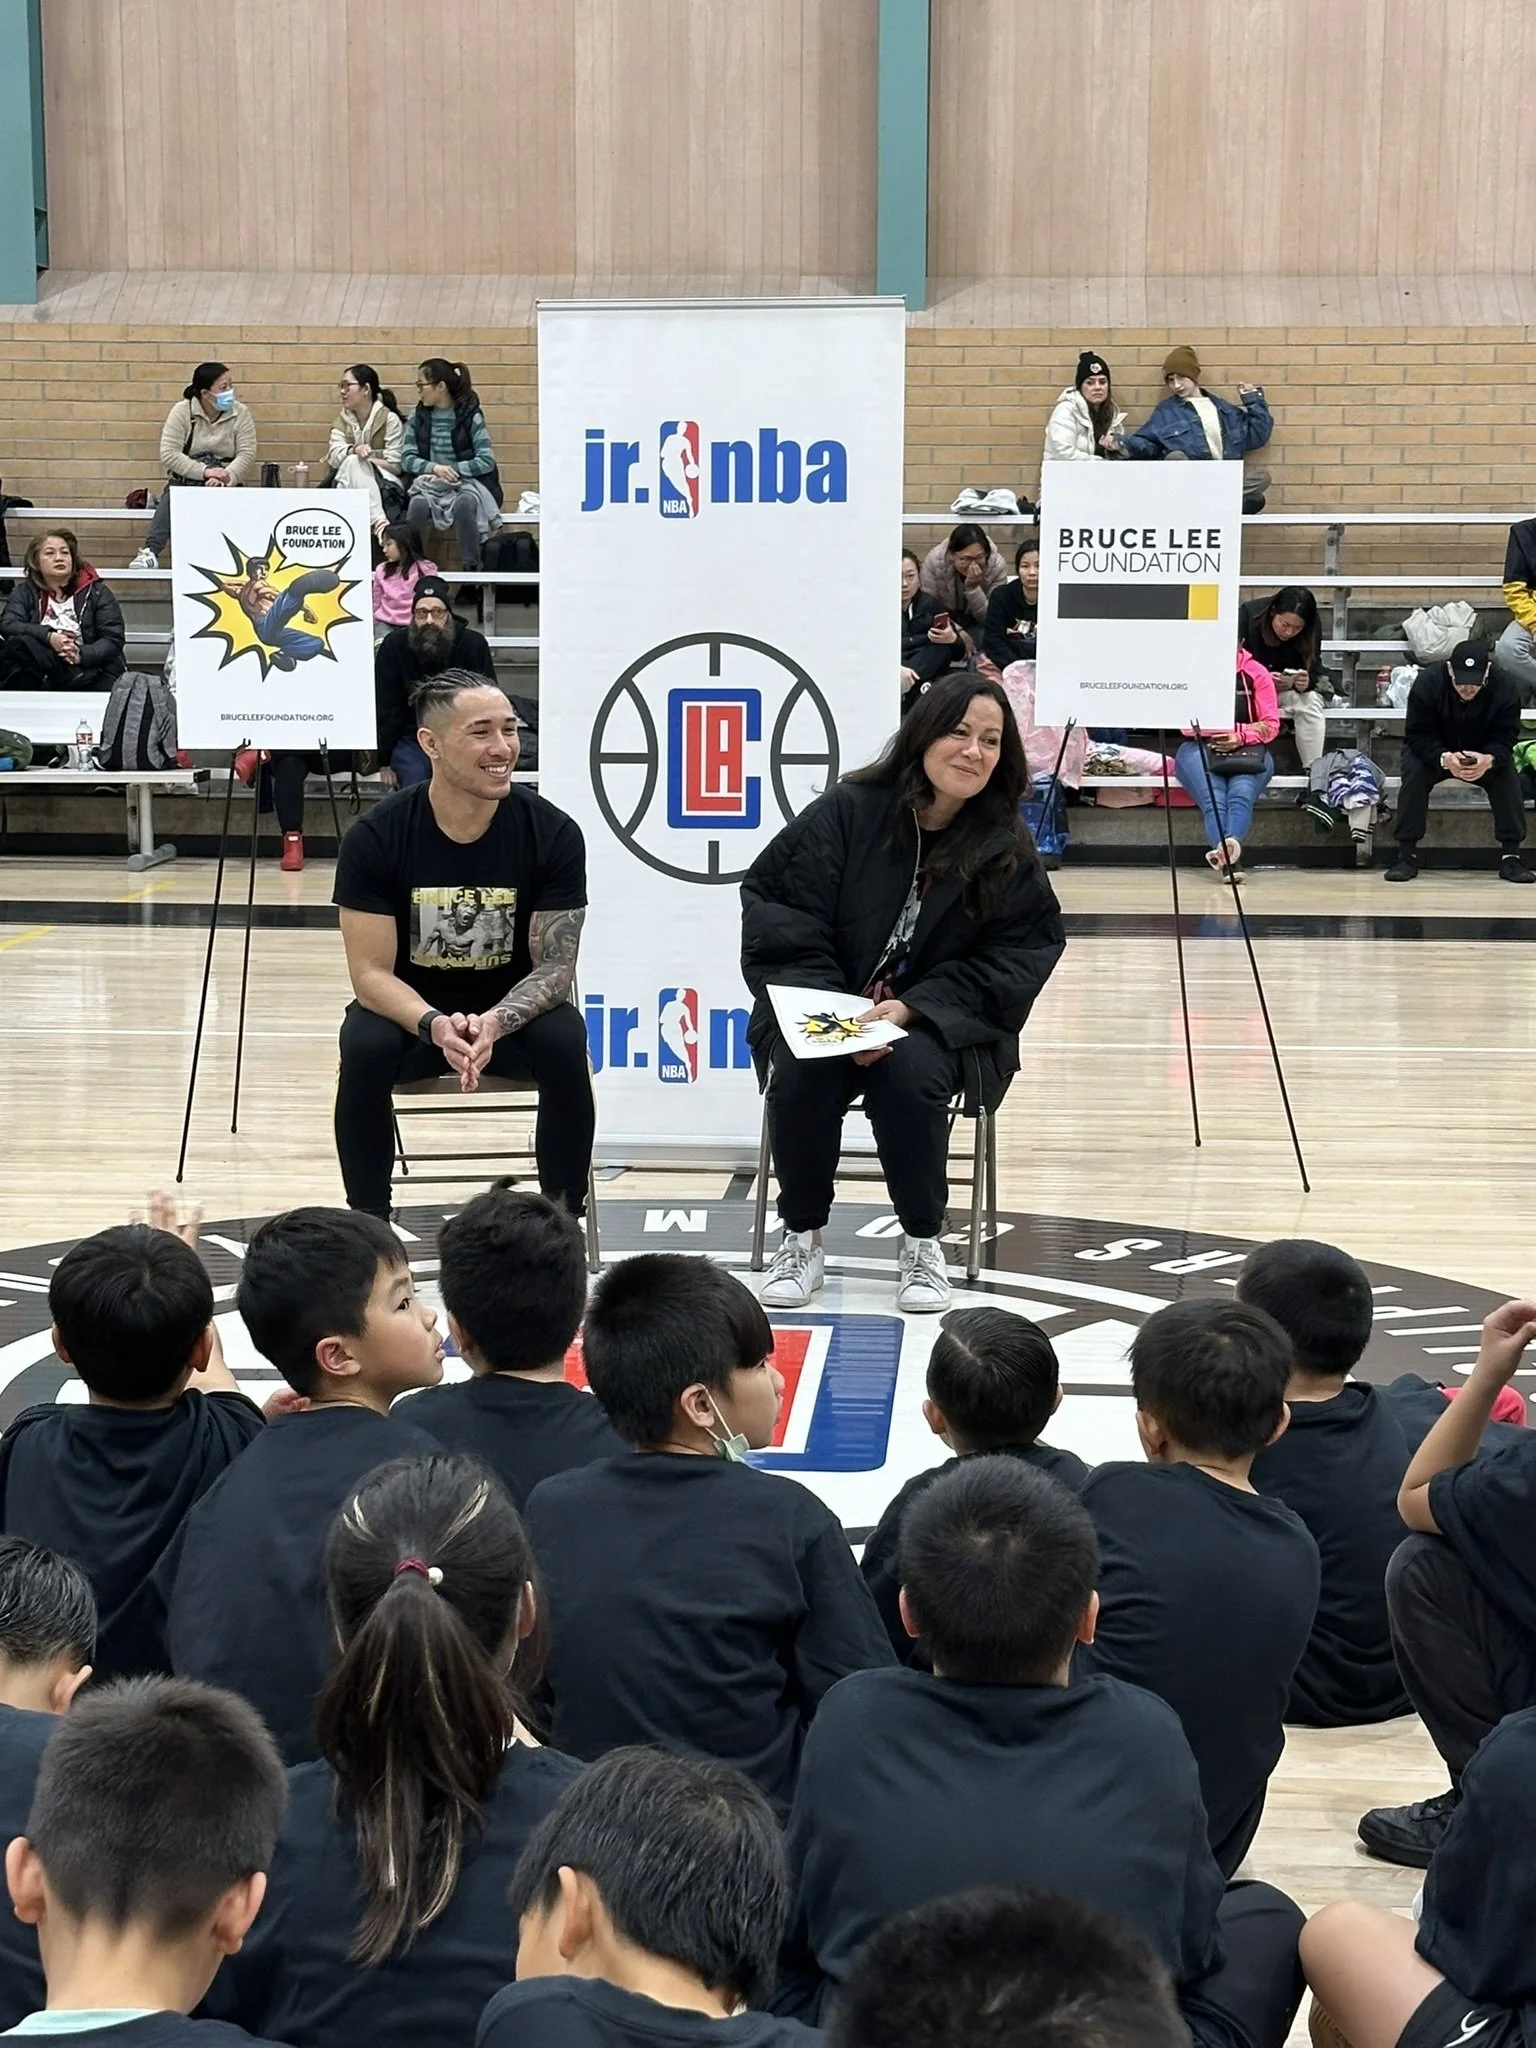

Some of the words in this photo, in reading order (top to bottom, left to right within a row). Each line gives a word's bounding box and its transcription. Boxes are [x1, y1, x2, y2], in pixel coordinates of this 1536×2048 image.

[581, 429, 649, 512] jr.
[711, 428, 848, 504] nba
[663, 500, 688, 514] NBA
[285, 525, 319, 536] BRUCE
[322, 526, 342, 536] LEE
[282, 538, 346, 549] FOUNDATION
[1059, 528, 1157, 549] BRUCE
[1168, 528, 1221, 549] LEE
[1058, 551, 1221, 573] FOUNDATION
[1079, 681, 1188, 691] BRUCELEEFOUNDATION.ORG
[220, 713, 335, 722] BRUCELEEFOUNDATION.ORG
[662, 1064, 687, 1079] NBA
